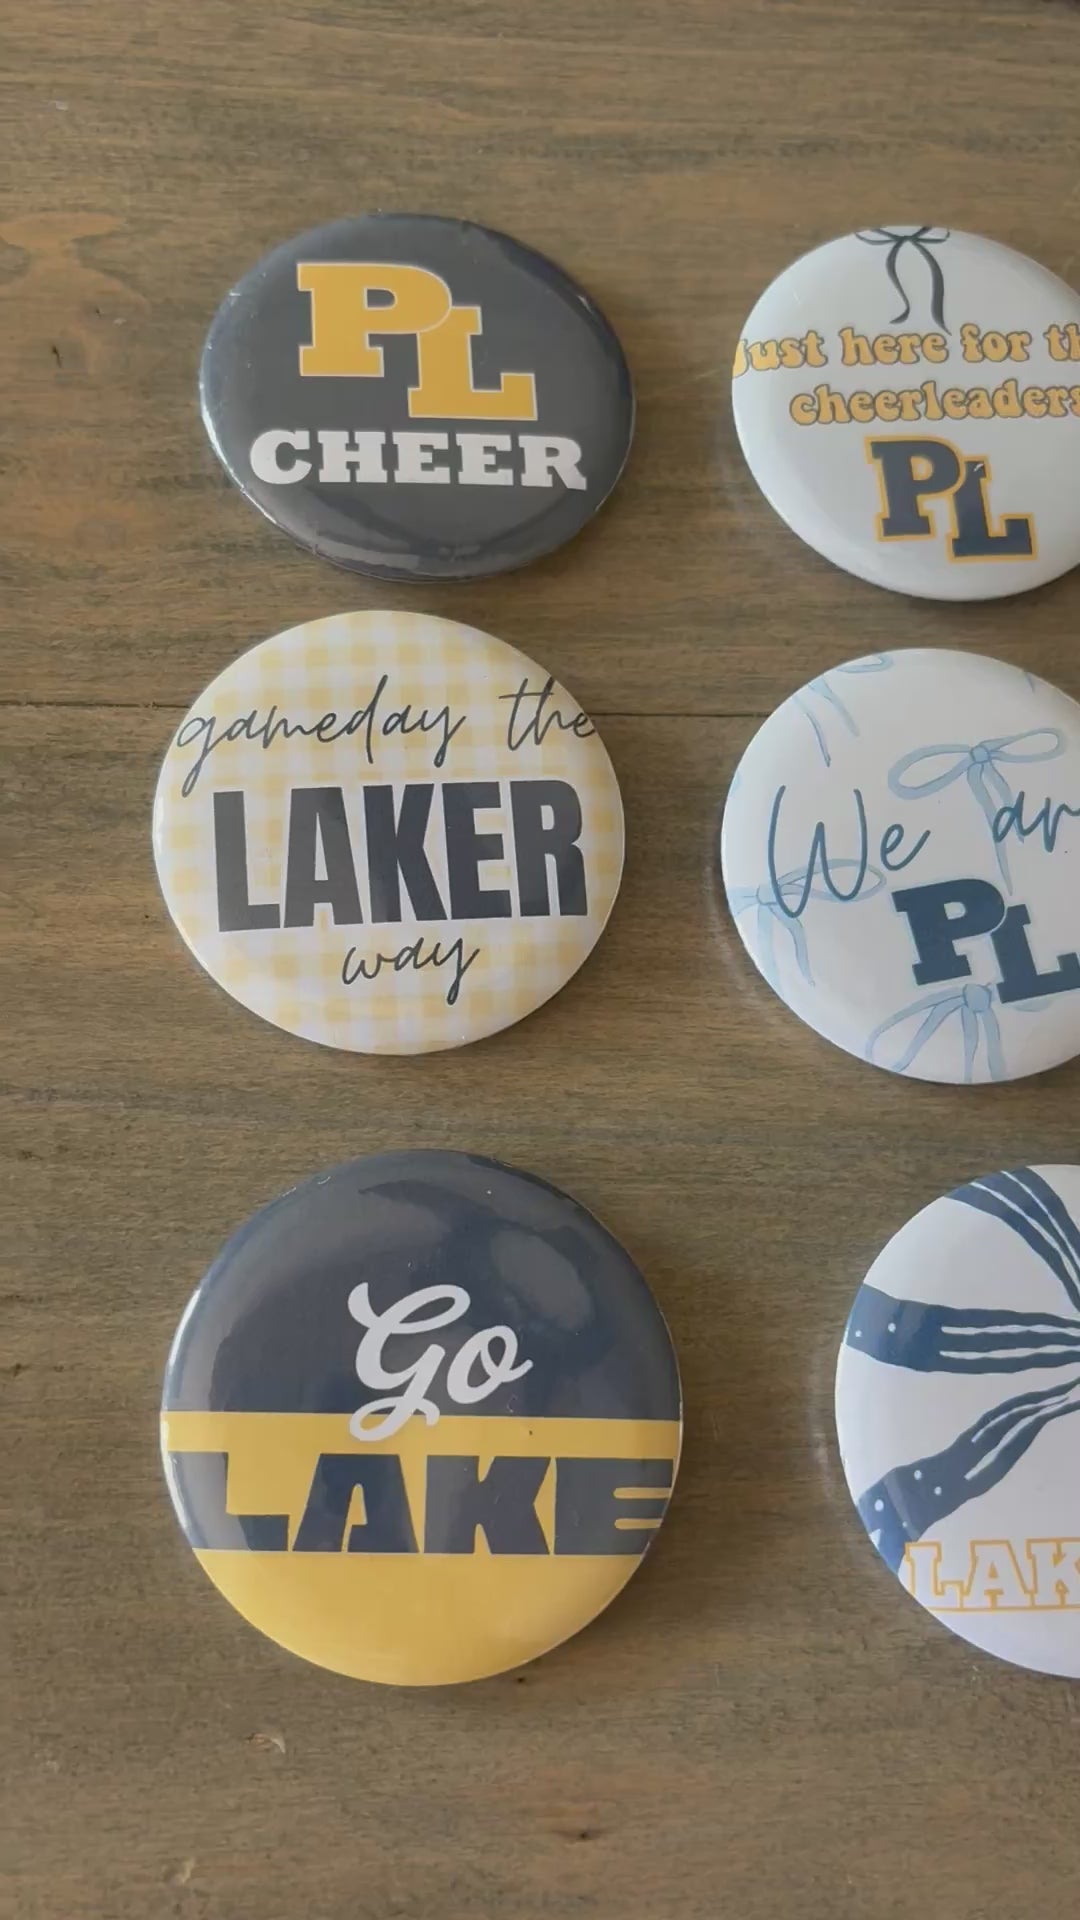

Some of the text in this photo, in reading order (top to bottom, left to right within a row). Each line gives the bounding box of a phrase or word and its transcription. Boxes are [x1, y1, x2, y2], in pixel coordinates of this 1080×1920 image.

[297, 262, 538, 420] PL
[838, 326, 950, 367] here
[960, 323, 1033, 363] for
[249, 429, 587, 491] CHEER
[864, 434, 1039, 565] PL
[176, 674, 597, 798] gameday the
[213, 779, 588, 933] LAKER
[768, 784, 931, 919] We
[341, 937, 481, 1006] way
[891, 878, 1080, 1004] PL
[347, 1281, 534, 1442] Go
[168, 1451, 674, 1556] LAKE
[904, 1536, 1080, 1613] LAK
